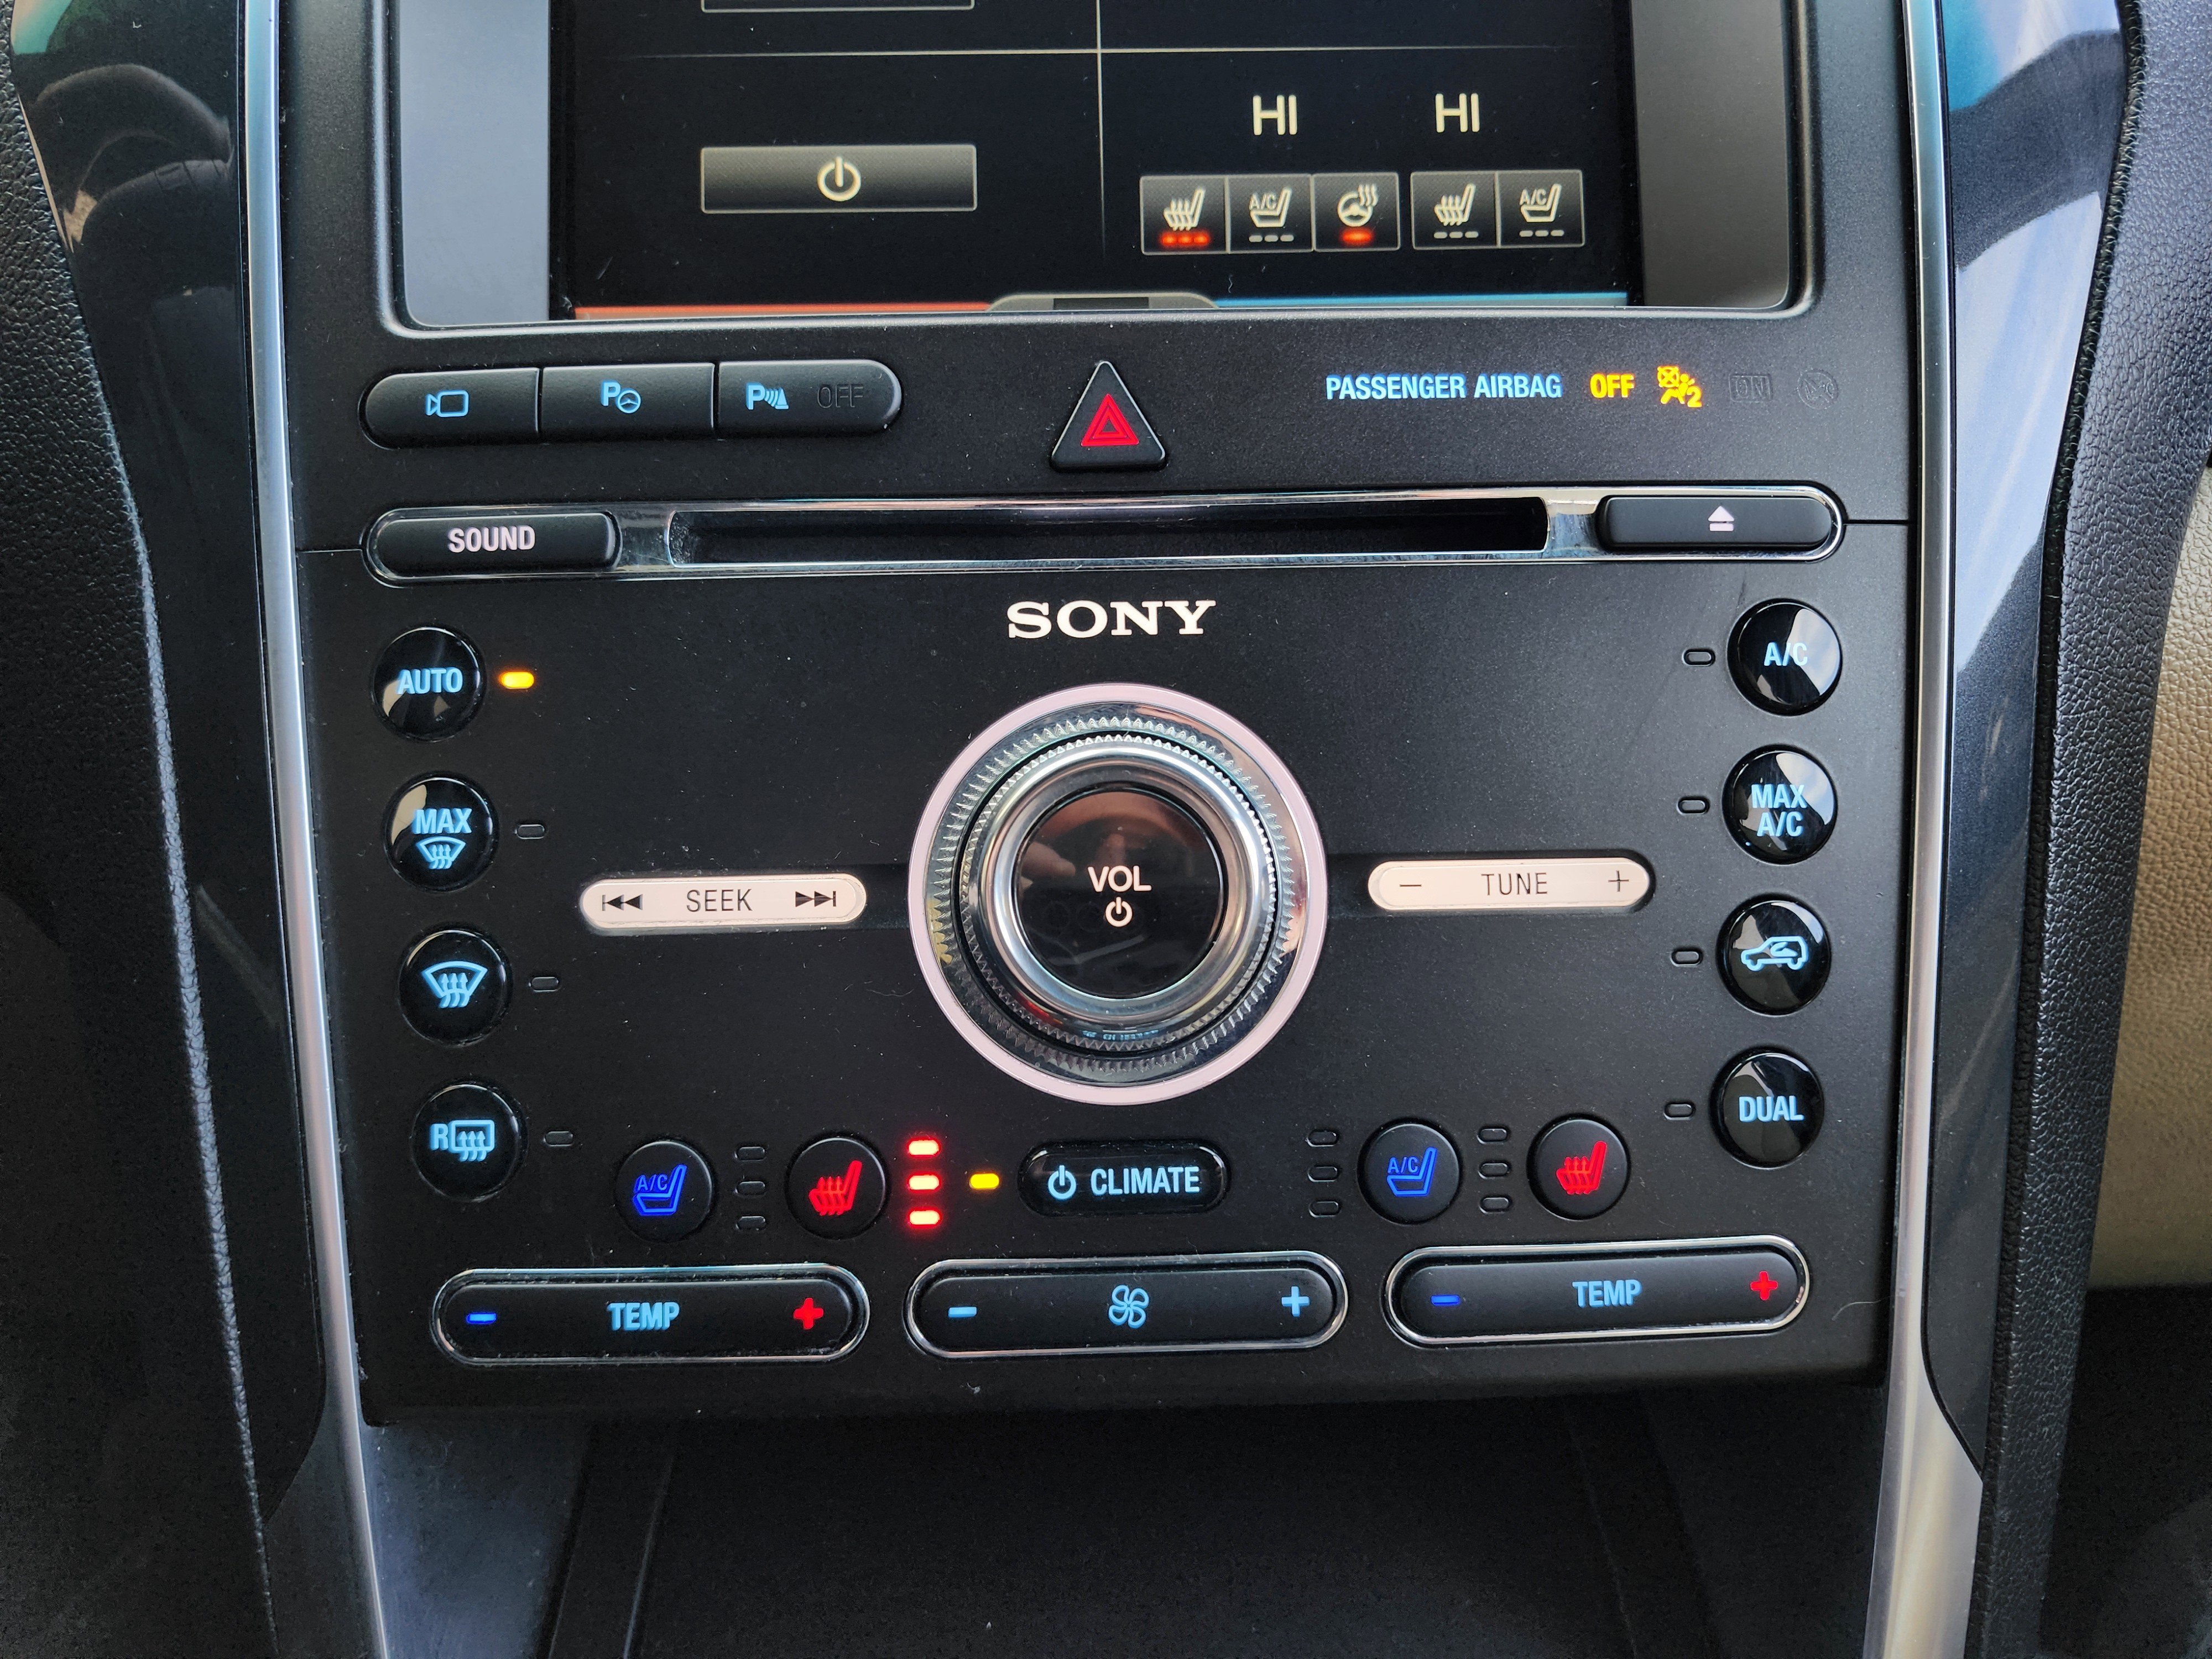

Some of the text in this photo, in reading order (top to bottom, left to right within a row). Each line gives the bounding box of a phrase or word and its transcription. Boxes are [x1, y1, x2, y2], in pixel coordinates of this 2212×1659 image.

[1253, 95, 1297, 136] HI
[1435, 93, 1480, 133] HI
[1249, 194, 1277, 210] A/C
[1519, 188, 1547, 205] A/C
[601, 380, 621, 406] P
[817, 383, 864, 409] OFF
[1326, 373, 1635, 400] PASSENGER AIRBAG OFF
[447, 525, 536, 554] SOUND
[1006, 600, 1216, 638] SONY
[1763, 640, 1808, 667] A/C
[397, 667, 463, 695] AUTO
[1751, 783, 1807, 810] MAX
[413, 807, 472, 835] MAX
[1756, 811, 1804, 838] A/C
[1088, 865, 1151, 892] VOL
[1481, 872, 1548, 896] TUNE
[686, 888, 753, 913] SEEK
[1739, 1095, 1805, 1122] DUAL
[431, 1123, 449, 1151] R
[1387, 1155, 1421, 1175] A/C
[635, 1173, 668, 1192] A/C
[1090, 1166, 1201, 1196] CLIMATE
[1572, 1279, 1642, 1308] TEMP
[607, 1301, 680, 1331] TEMP
